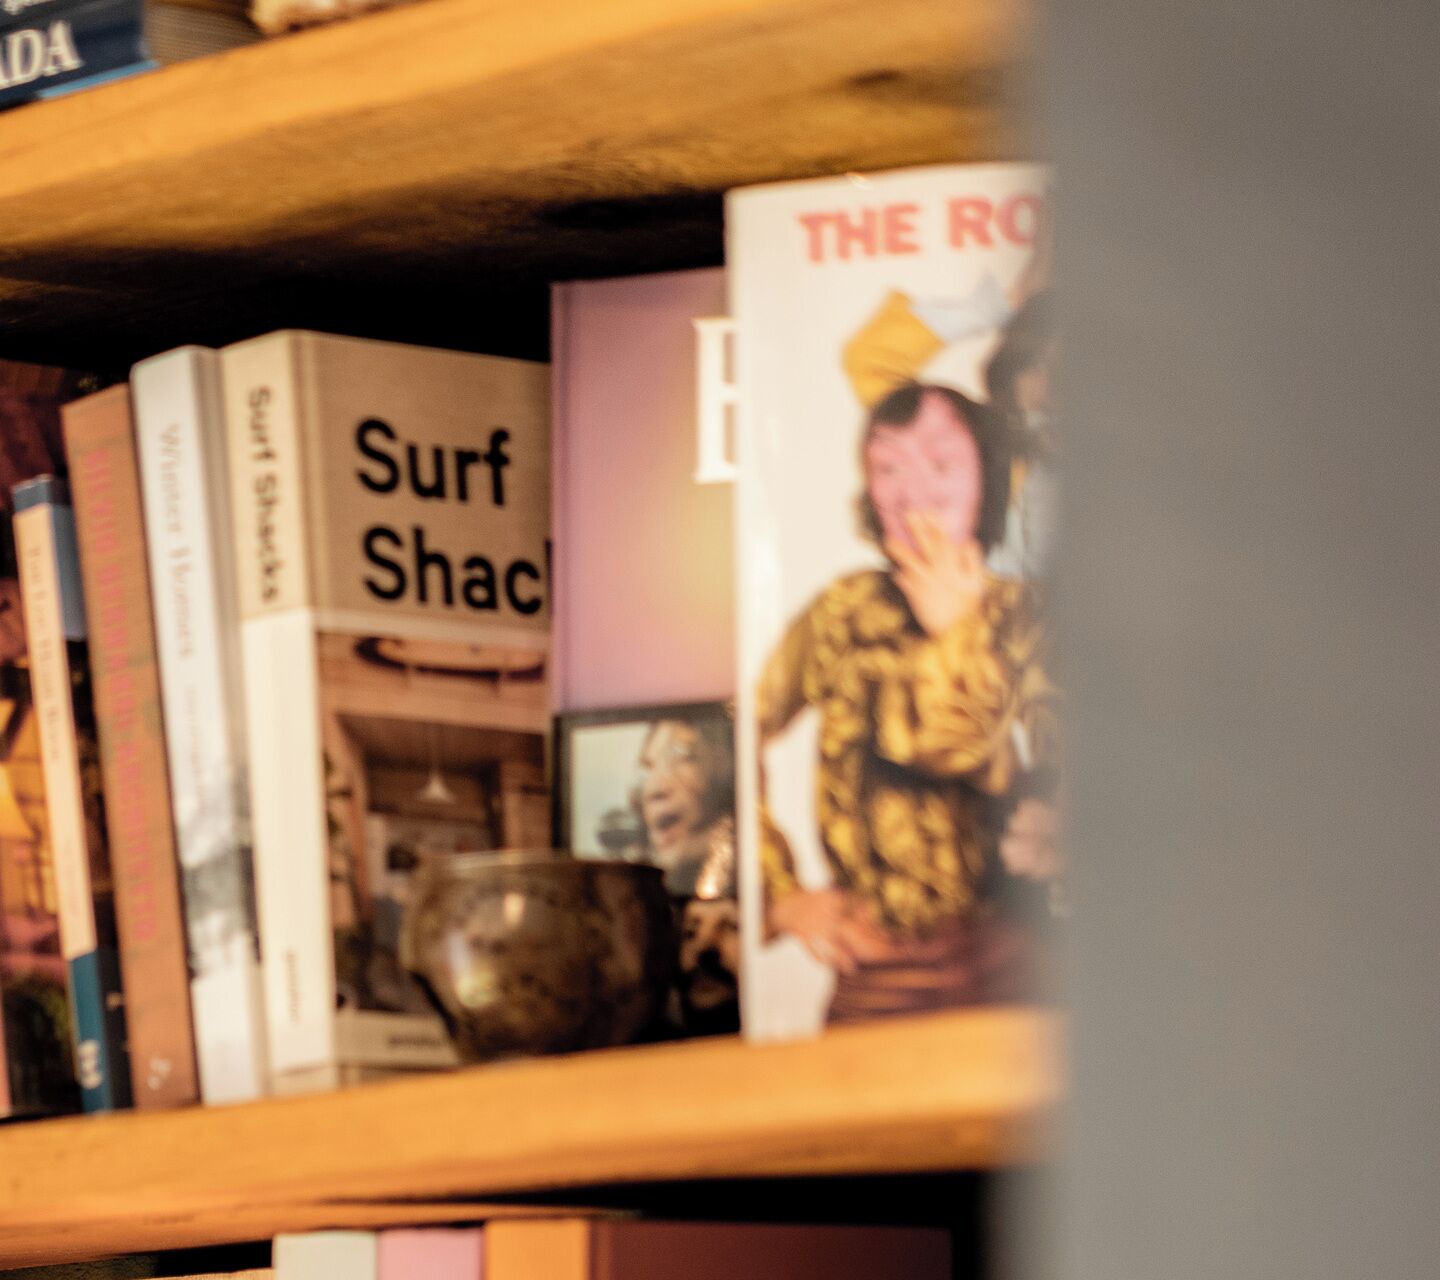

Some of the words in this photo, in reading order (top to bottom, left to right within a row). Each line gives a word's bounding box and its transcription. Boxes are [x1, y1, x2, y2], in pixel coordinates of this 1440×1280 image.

[798, 202, 923, 265] THE
[356, 419, 512, 507] Surf
[362, 526, 551, 616] Shac
